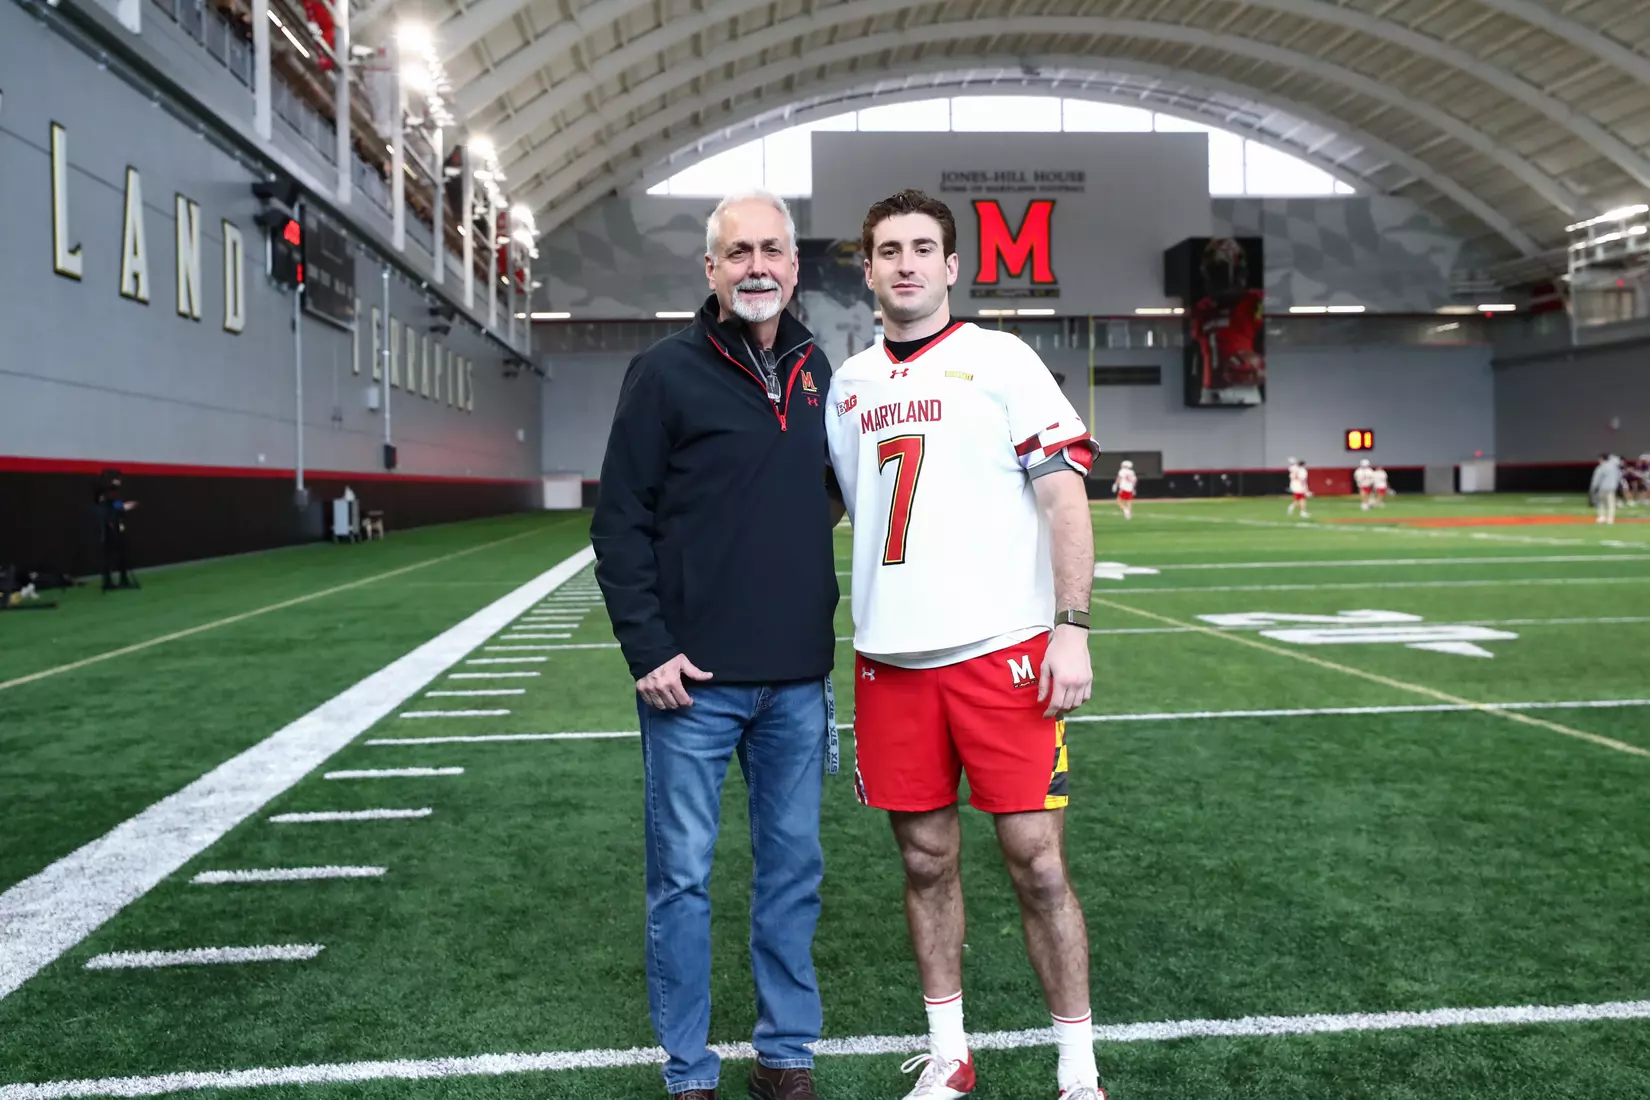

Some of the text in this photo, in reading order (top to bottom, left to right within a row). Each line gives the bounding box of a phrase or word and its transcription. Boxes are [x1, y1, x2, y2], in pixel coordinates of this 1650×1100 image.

[940, 170, 1086, 183] JONES-HILL HOUSE
[970, 199, 1059, 285] M
[800, 369, 818, 390] M
[861, 399, 942, 434] MARYLAND
[877, 434, 925, 566] 7
[1006, 654, 1037, 684] M
[829, 726, 838, 746] STX
